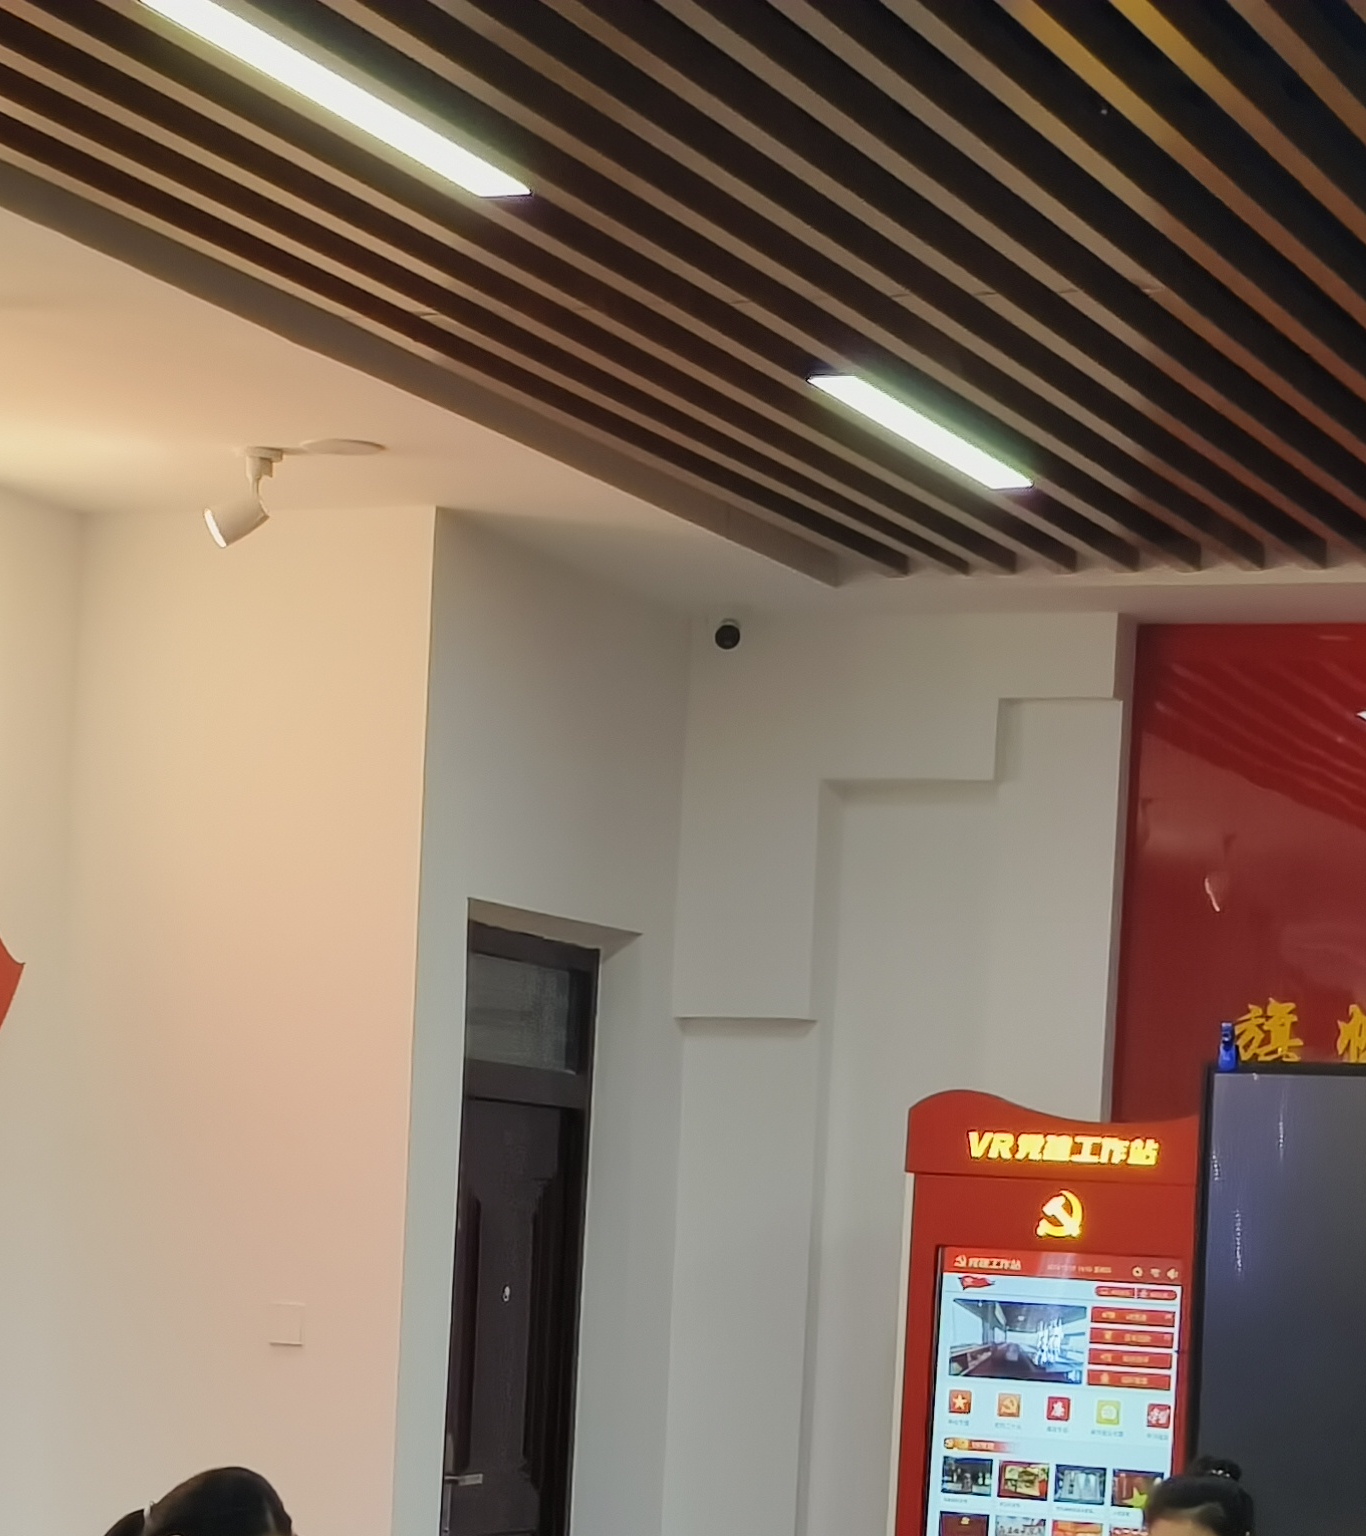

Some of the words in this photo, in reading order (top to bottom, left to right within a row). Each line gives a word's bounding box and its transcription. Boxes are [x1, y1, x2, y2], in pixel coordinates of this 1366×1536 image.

[967, 1130, 1160, 1166] VR党建工作站
